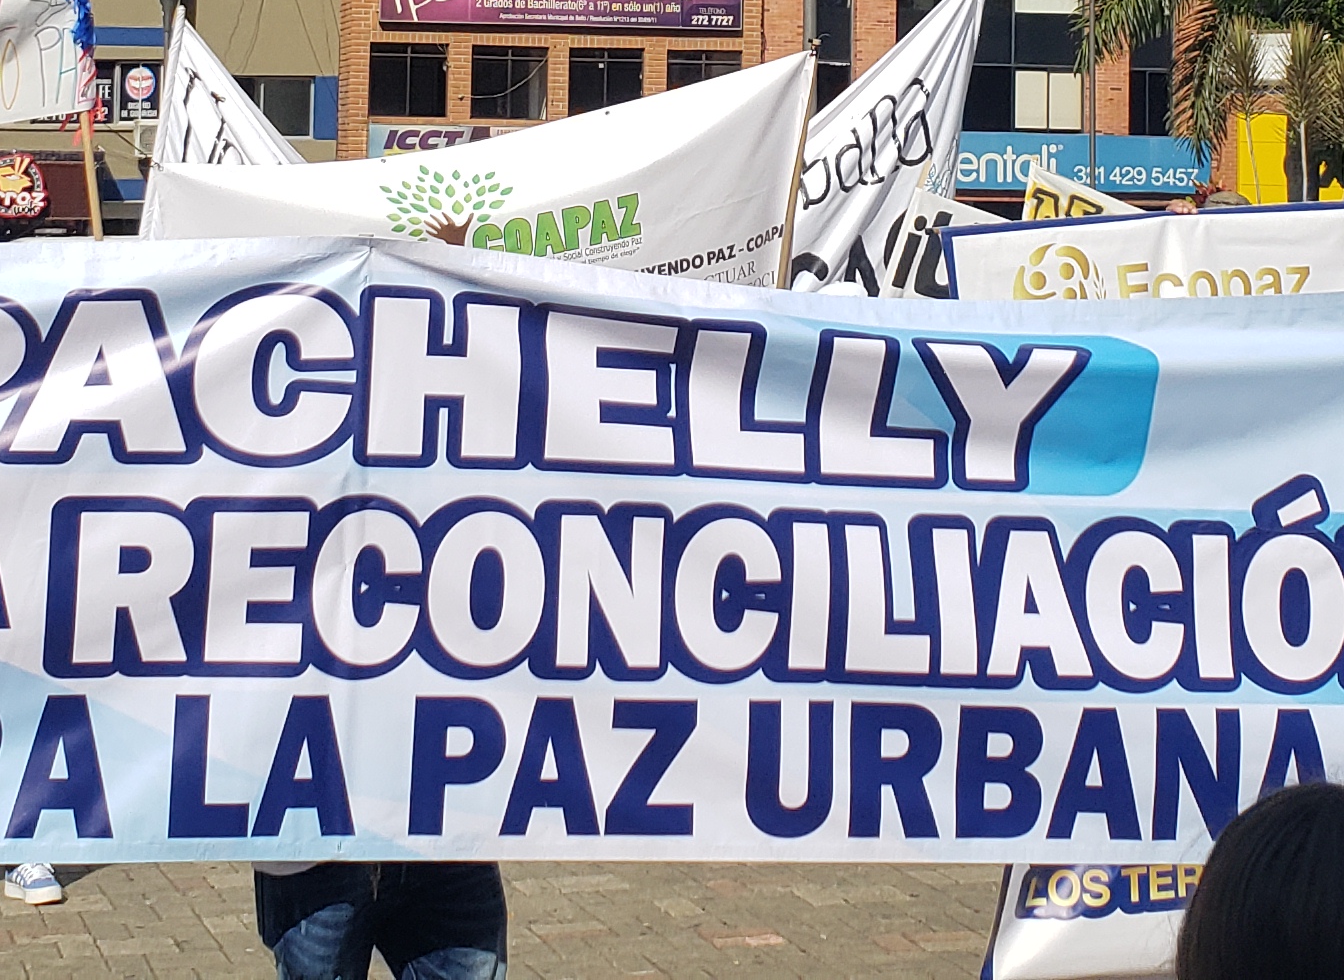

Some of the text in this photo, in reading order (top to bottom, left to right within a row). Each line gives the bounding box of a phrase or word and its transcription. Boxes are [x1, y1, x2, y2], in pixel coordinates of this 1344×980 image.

[612, 3, 622, 11] en
[665, 2, 681, 13] año
[691, 15, 734, 26] 272 7727
[383, 129, 465, 150] ICCT
[957, 144, 1057, 182] entali
[1109, 167, 1146, 185] 429
[1151, 167, 1199, 187] 5457
[472, 192, 642, 258] COAPAZ
[706, 244, 737, 266] PAZ
[167, 696, 355, 839] LA
[408, 696, 698, 838] PAZ
[746, 700, 1327, 842] URBANA
[1025, 868, 1111, 908] LOS
